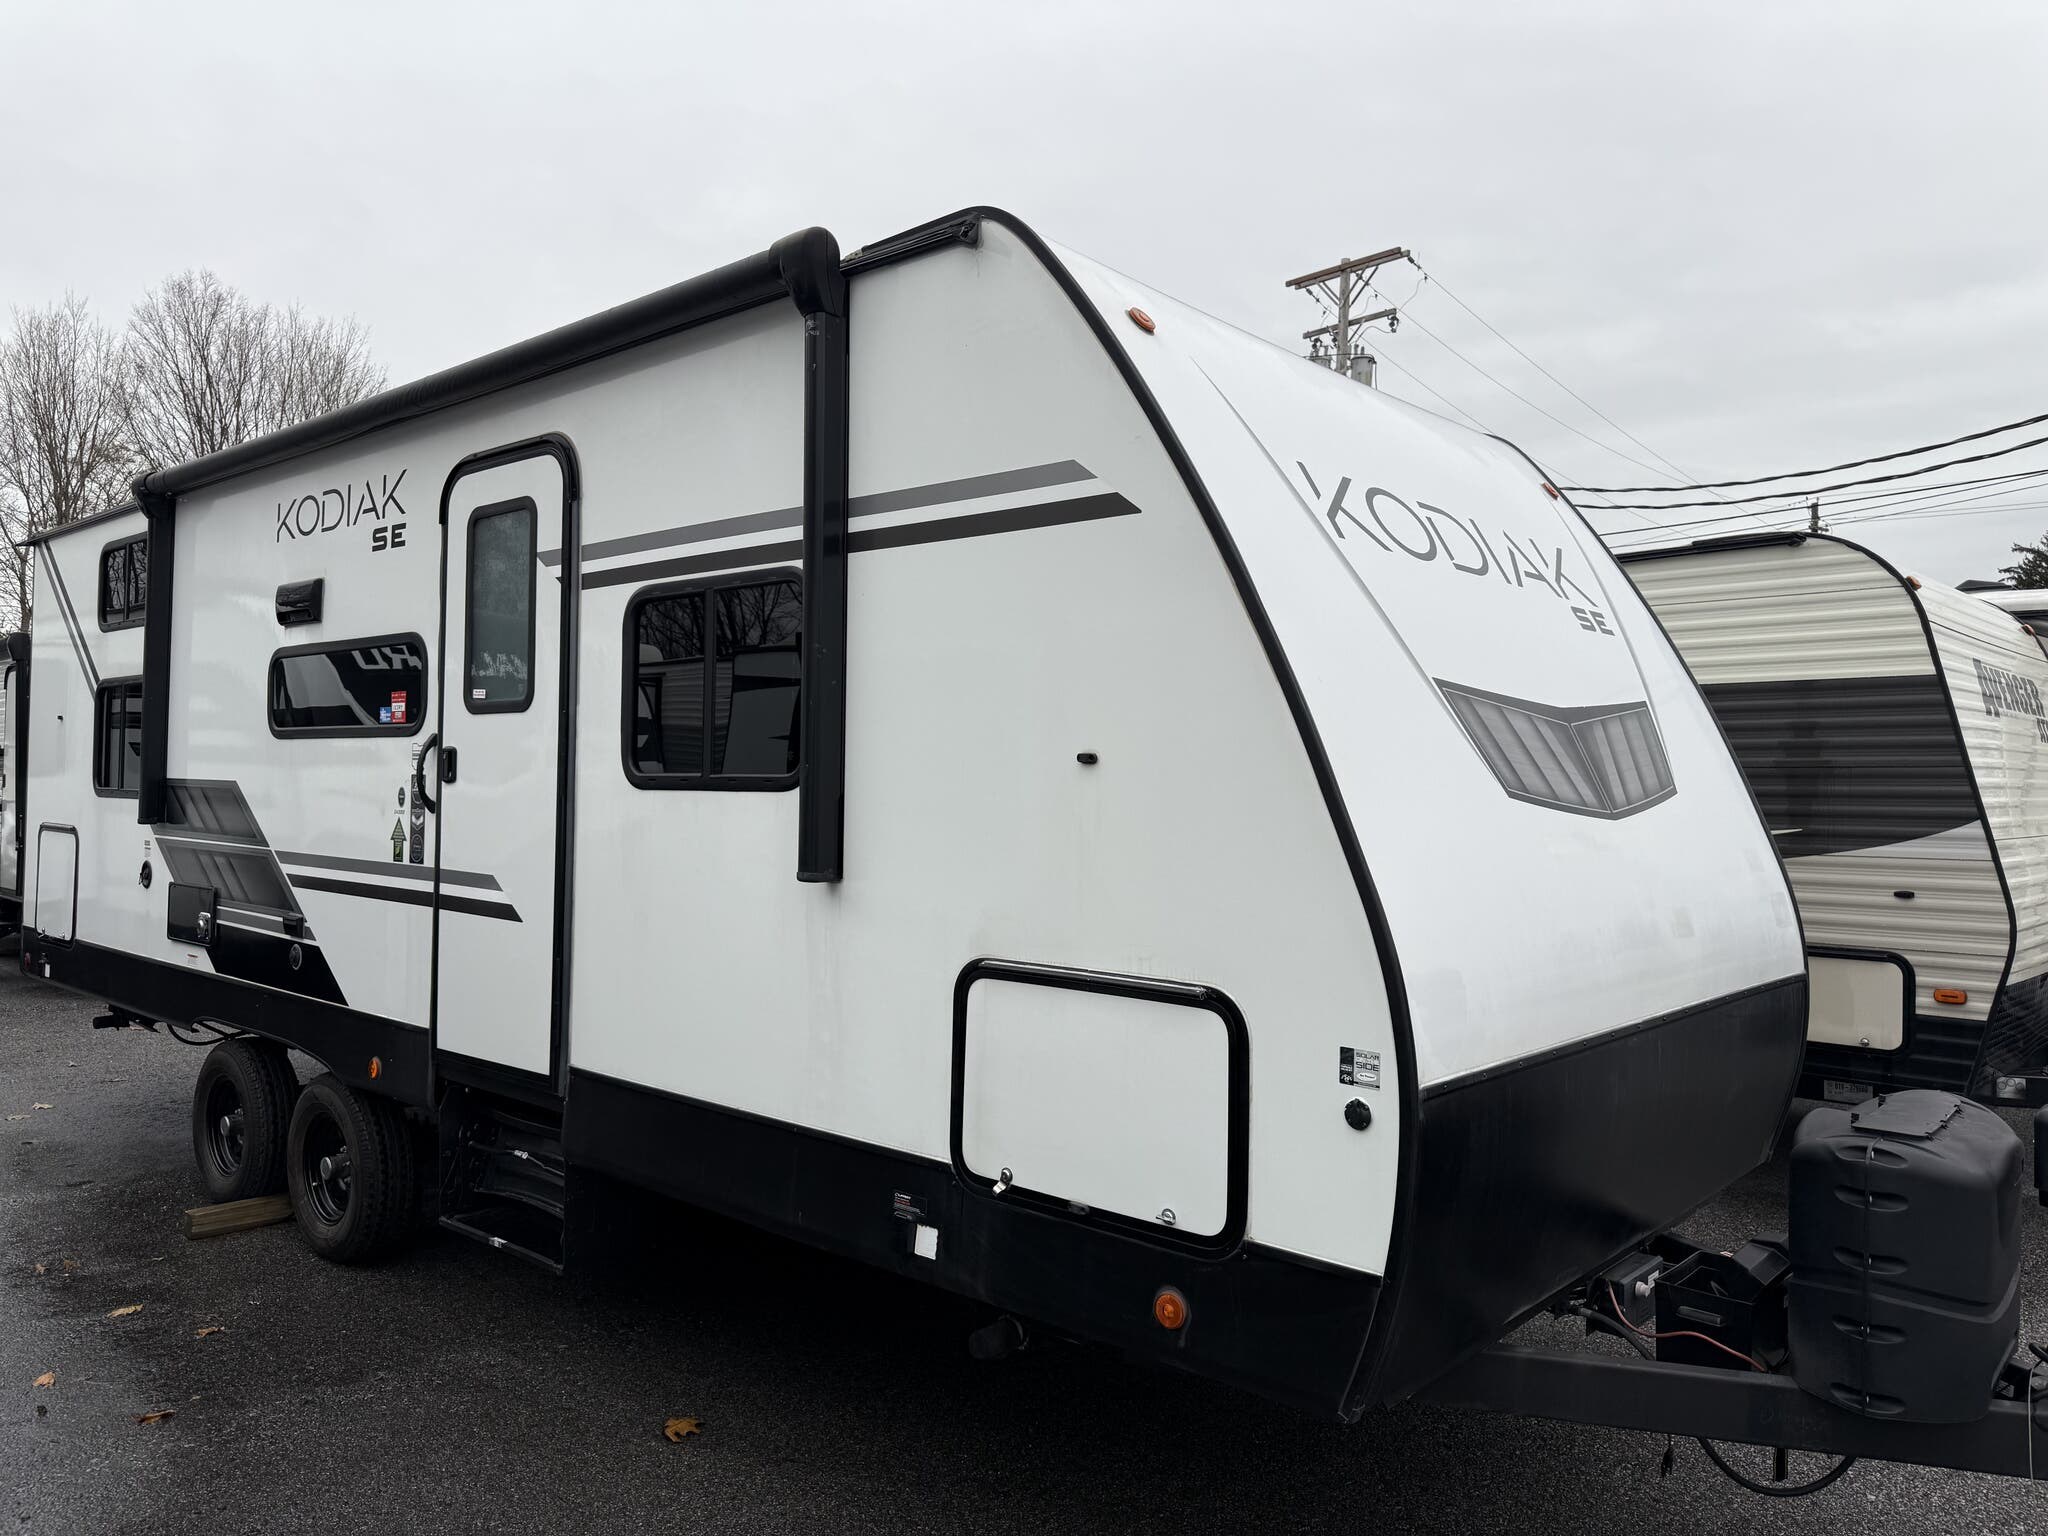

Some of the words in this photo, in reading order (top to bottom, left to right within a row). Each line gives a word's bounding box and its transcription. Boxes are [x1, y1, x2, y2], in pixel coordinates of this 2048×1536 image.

[276, 468, 408, 544] KODIAK
[371, 522, 407, 552] SE
[1296, 461, 1598, 607] KODIAK
[1570, 606, 1616, 636] SE
[1973, 658, 2046, 718] AVENGER
[1355, 1061, 1380, 1072] SIDE
